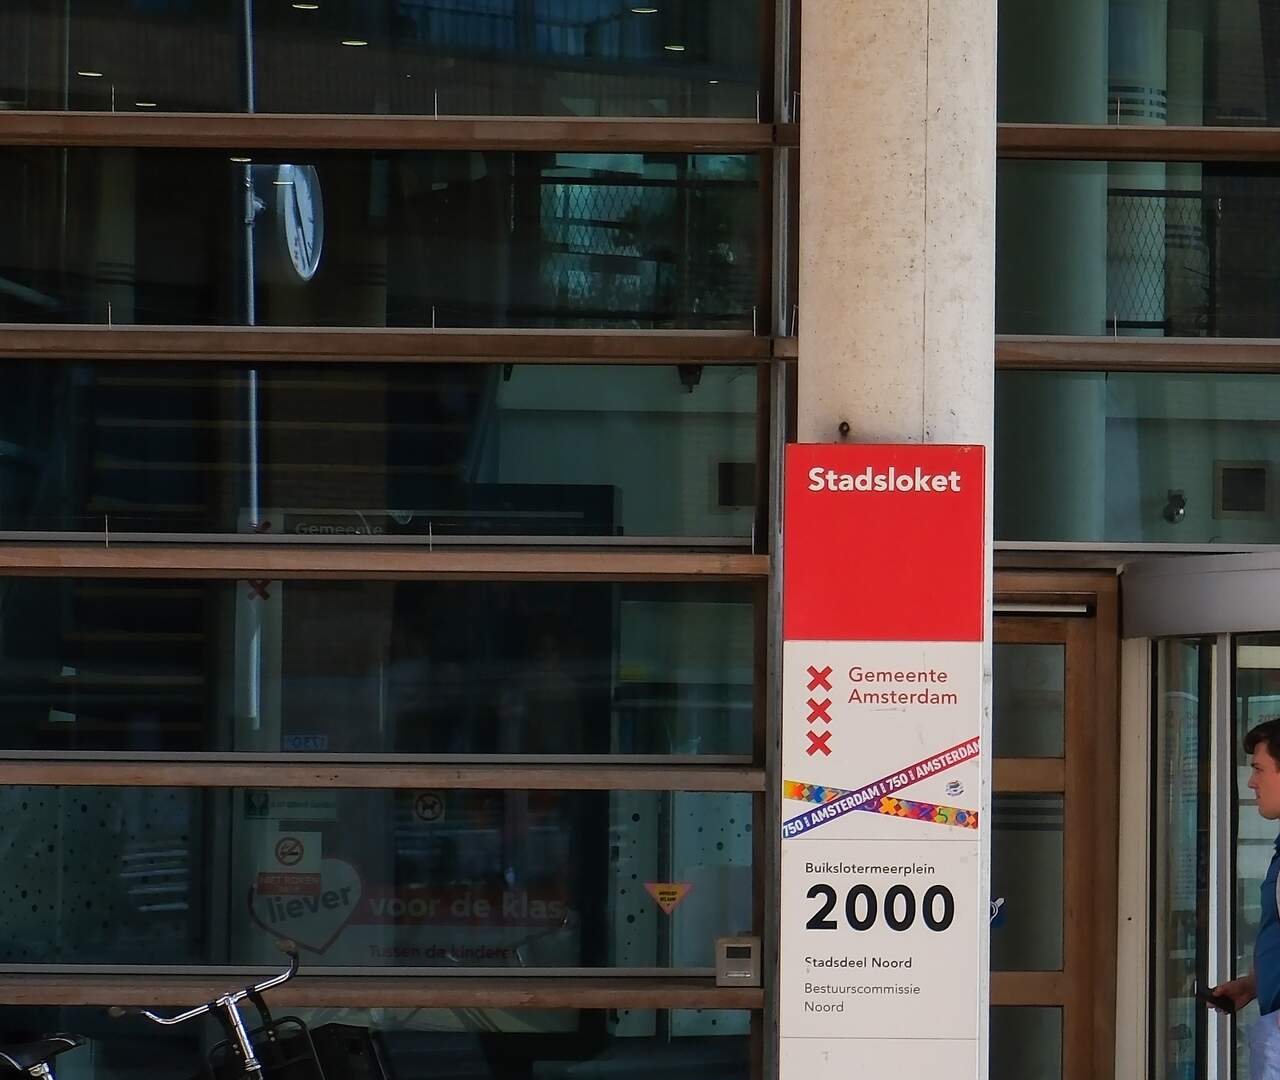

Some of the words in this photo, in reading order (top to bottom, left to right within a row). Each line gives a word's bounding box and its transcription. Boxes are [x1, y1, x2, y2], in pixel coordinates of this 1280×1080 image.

[808, 466, 960, 492] Stadsloket
[848, 666, 948, 682] Gemeente
[848, 688, 957, 704] Amsterdam
[783, 821, 804, 837] 750
[810, 786, 880, 825] AMSTERDAM
[886, 773, 908, 791] 750
[805, 862, 935, 877] Buikslotermeerplein
[369, 896, 440, 919] voor
[450, 891, 492, 919] de
[806, 884, 954, 931] 2000
[369, 944, 421, 960] Tussen
[425, 944, 447, 960] de
[452, 944, 520, 960] kindere
[805, 957, 867, 968] Stadsdeel
[872, 957, 912, 968] Noord
[804, 982, 920, 995] Bestuurscommissie
[804, 1001, 844, 1012] Noord
